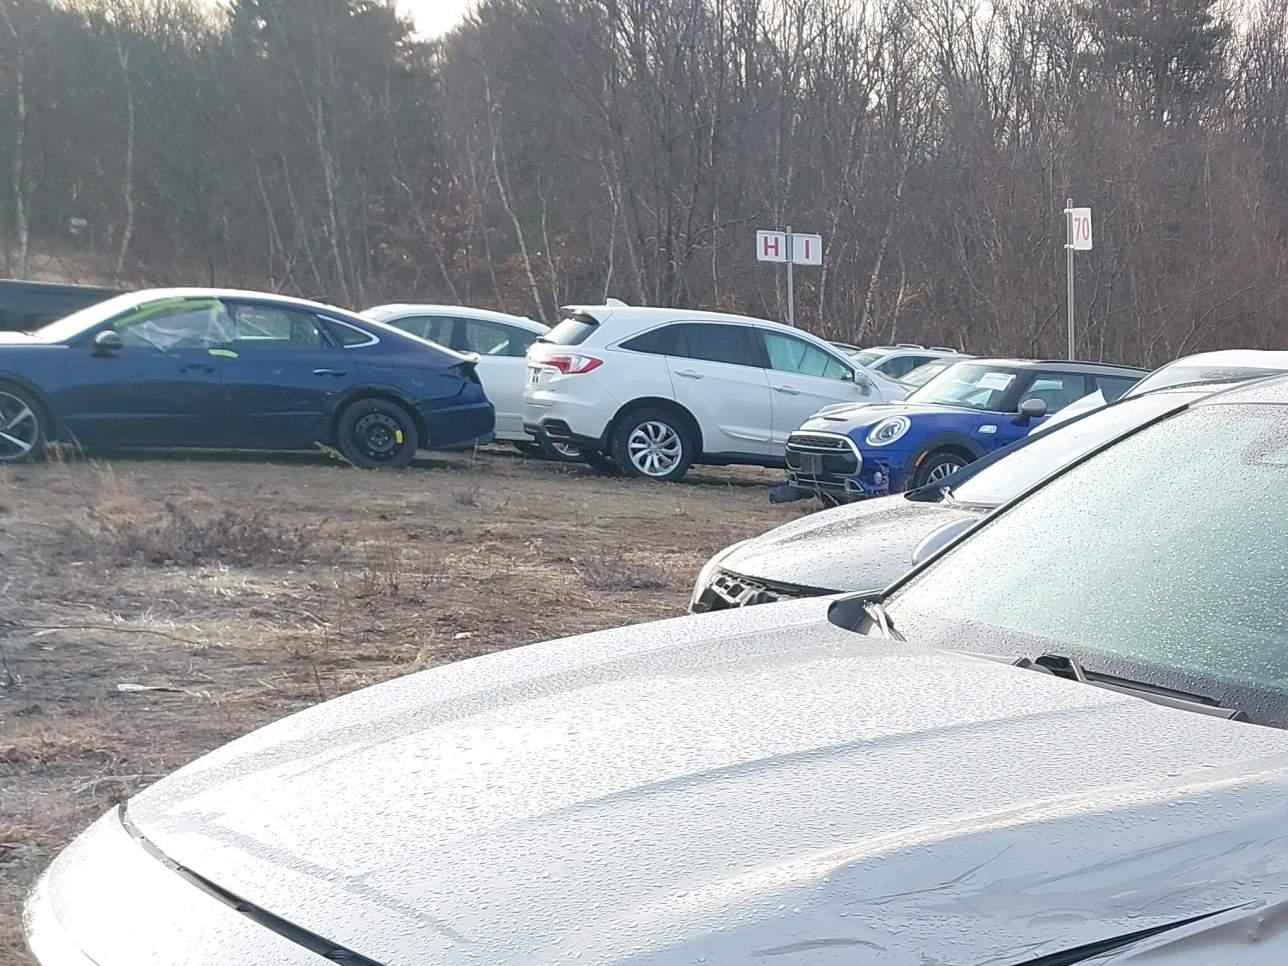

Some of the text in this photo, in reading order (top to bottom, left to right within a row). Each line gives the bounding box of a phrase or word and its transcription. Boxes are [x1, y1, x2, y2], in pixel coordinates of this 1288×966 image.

[1074, 216, 1090, 241] 70
[763, 236, 780, 257] H
[804, 239, 811, 260] I
